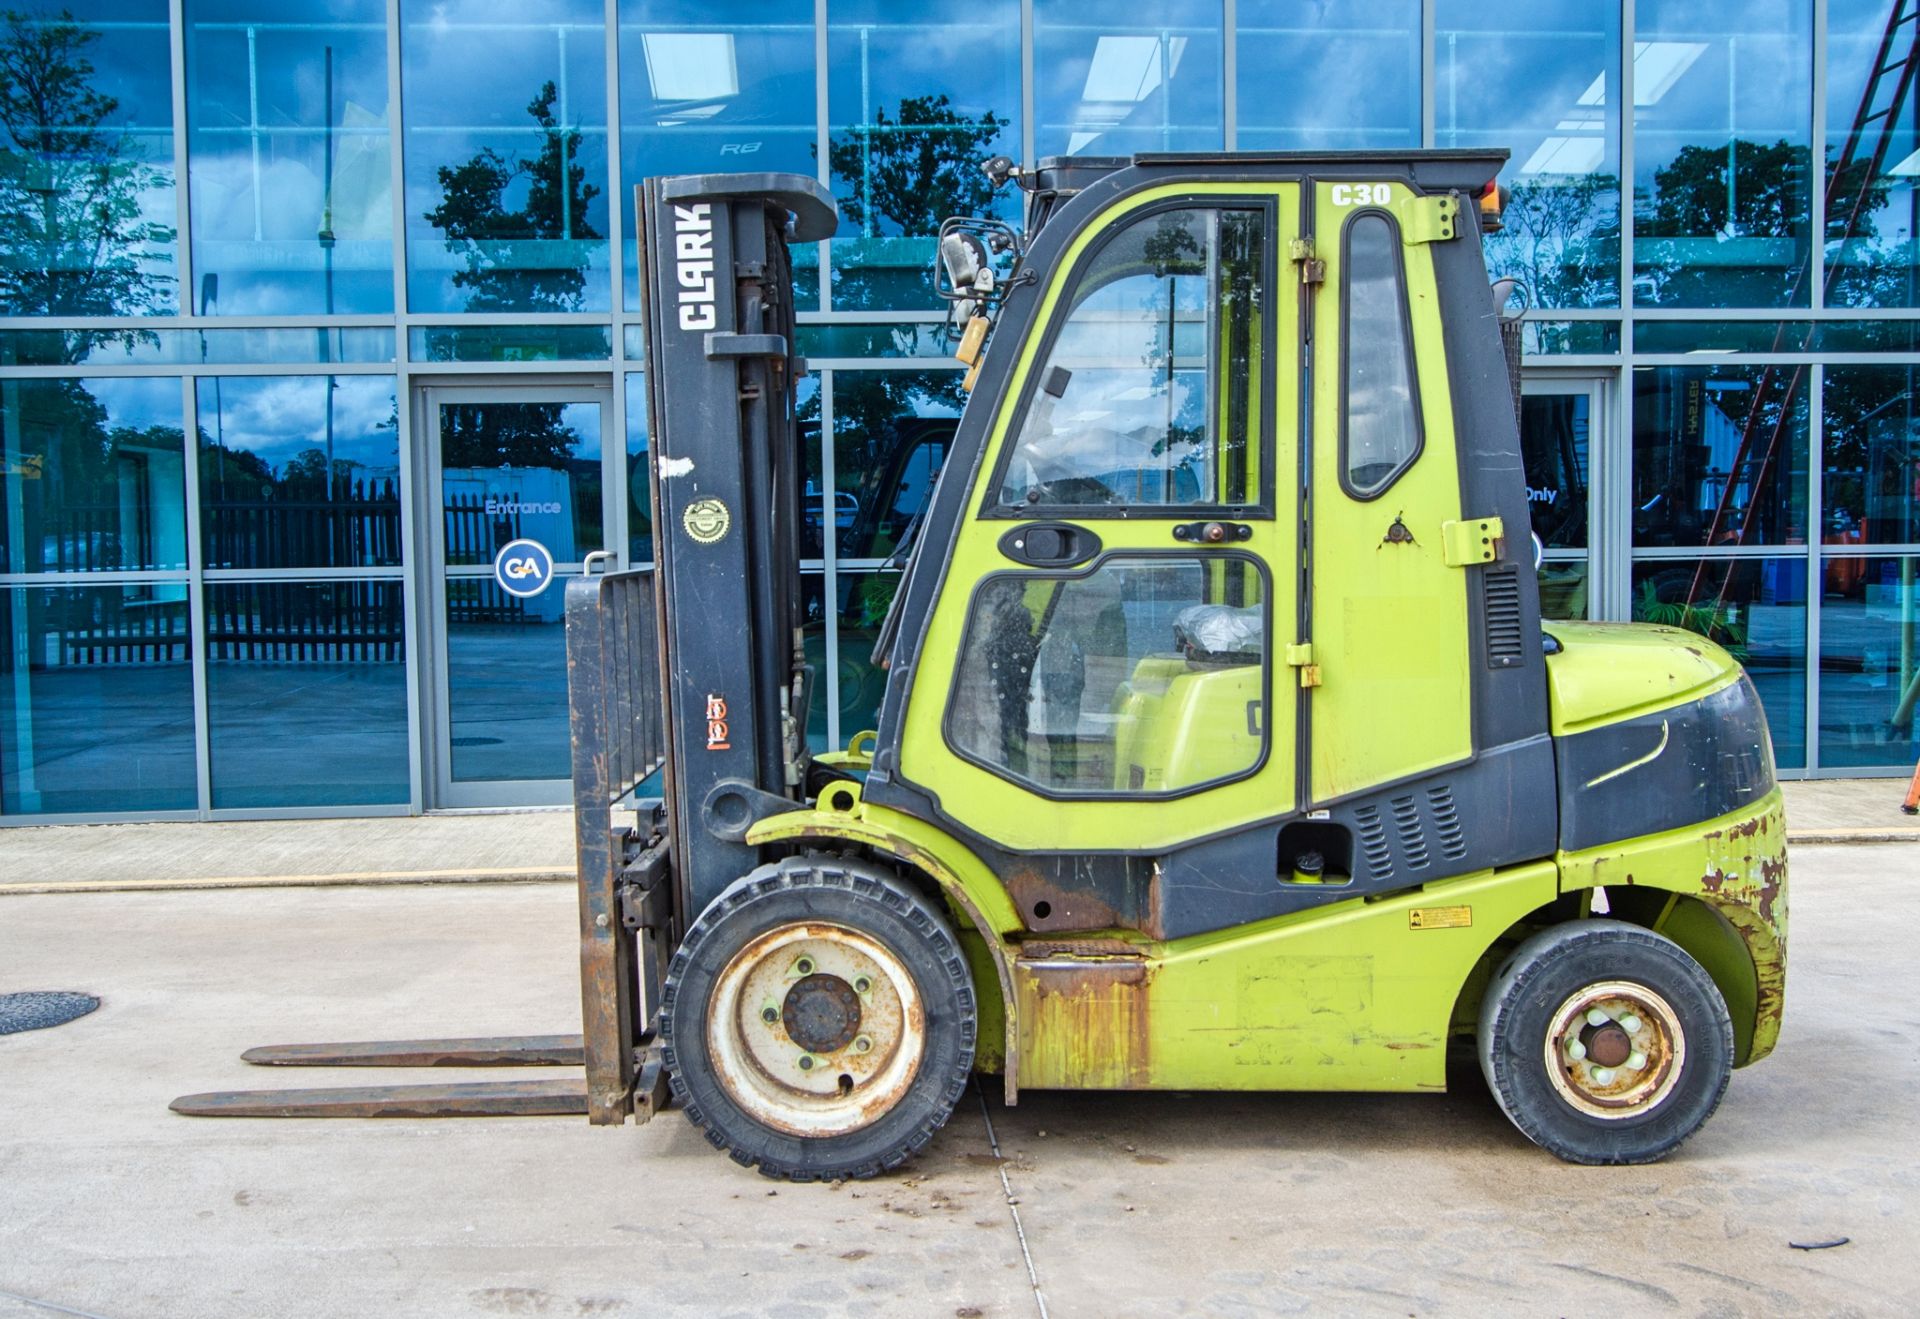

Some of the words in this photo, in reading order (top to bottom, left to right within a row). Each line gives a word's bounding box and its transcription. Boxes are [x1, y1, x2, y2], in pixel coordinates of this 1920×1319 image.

[1332, 183, 1391, 206] C30
[674, 203, 716, 331] CLARK
[485, 499, 561, 515] Entrance
[504, 557, 542, 579] GA
